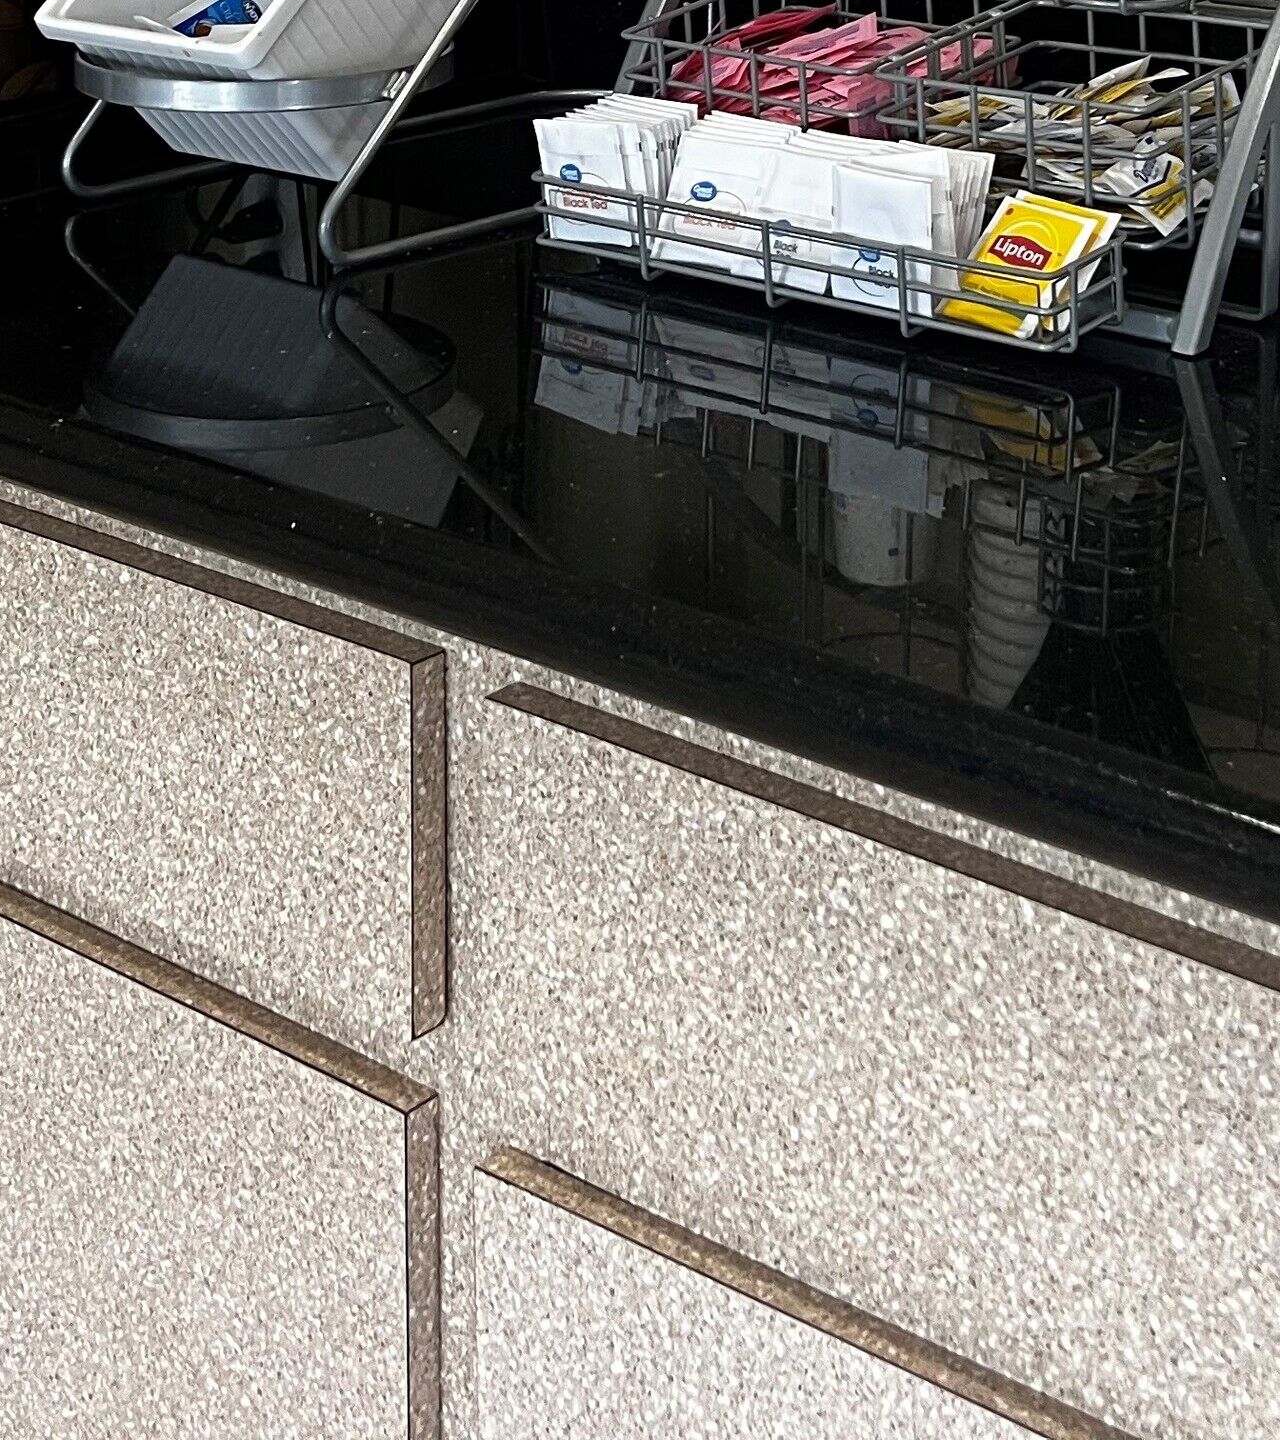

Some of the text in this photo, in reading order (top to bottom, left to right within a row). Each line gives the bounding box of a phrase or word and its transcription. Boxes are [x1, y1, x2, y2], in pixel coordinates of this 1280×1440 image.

[563, 196, 589, 209] Black
[774, 240, 799, 254] Black
[993, 237, 1045, 266] Lipton
[868, 265, 894, 279] Black
